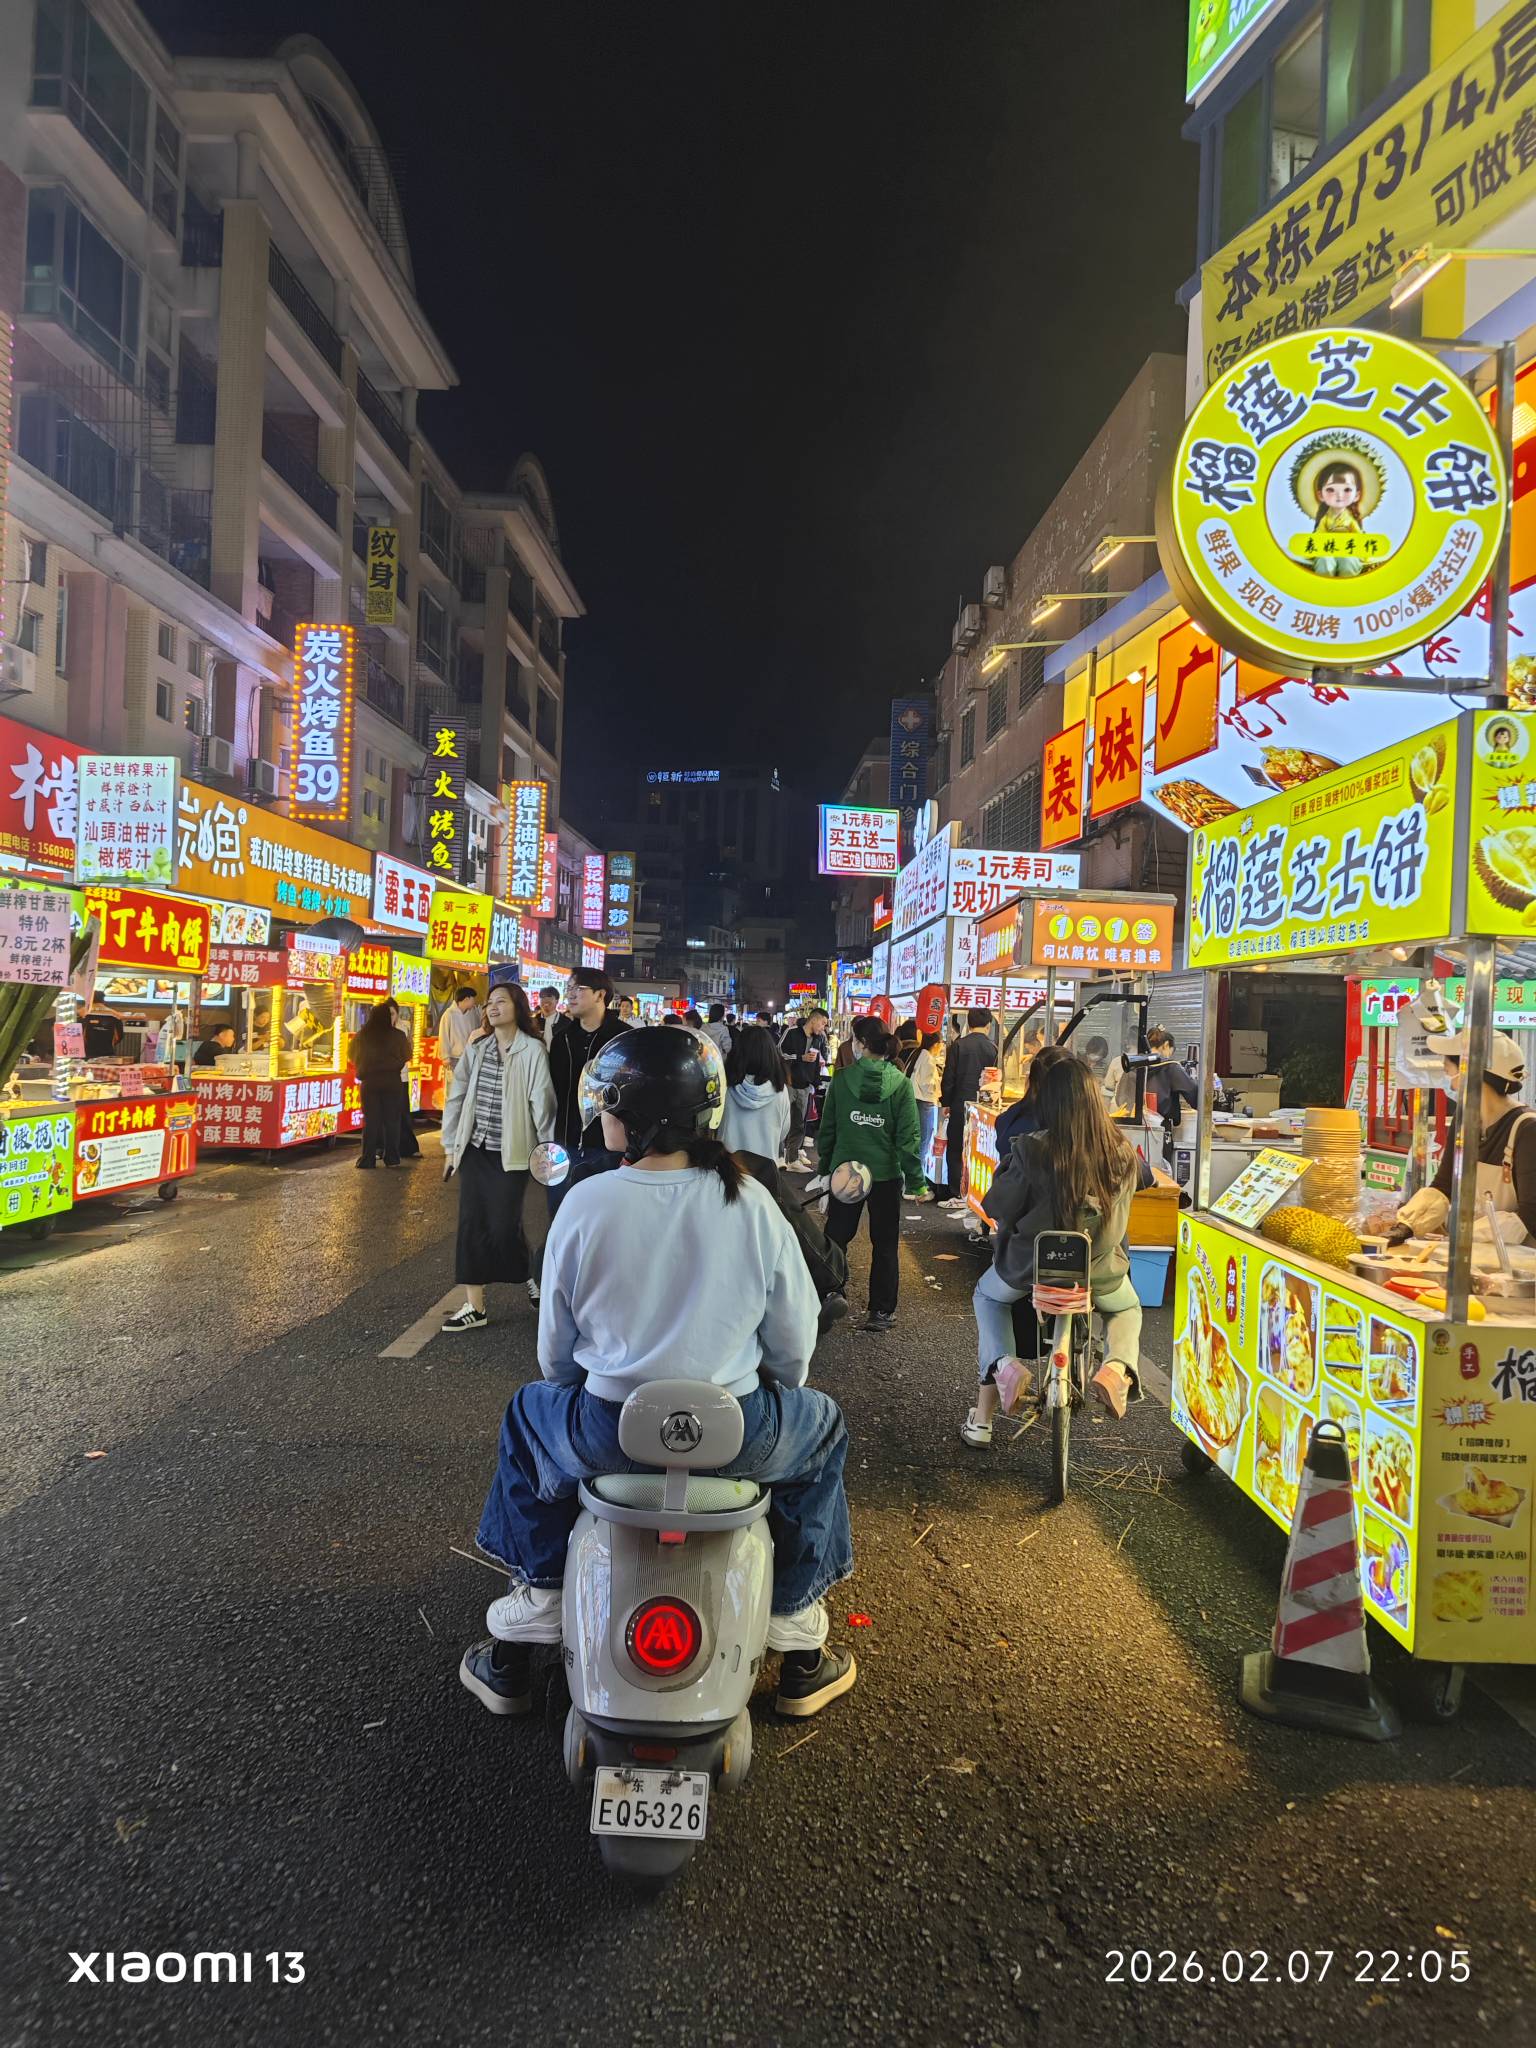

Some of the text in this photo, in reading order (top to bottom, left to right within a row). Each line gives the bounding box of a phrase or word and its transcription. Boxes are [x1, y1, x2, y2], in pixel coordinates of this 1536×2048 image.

[1186, 339, 1497, 512] 榴莲芝士饼
[369, 530, 396, 591] 纹身
[1204, 528, 1242, 579] 鲜果
[1237, 577, 1283, 622] 现包
[1291, 609, 1341, 639] 现烤
[300, 631, 343, 761] 炭火烤鱼
[86, 762, 168, 778] 吴记鲜榨果汁
[1045, 755, 1078, 824] 表
[1095, 706, 1138, 789] 妹
[295, 763, 340, 803] 39
[427, 728, 460, 869] 炭火烤鱼
[84, 822, 167, 844] 汕頭油柑汁
[842, 813, 883, 829] 1元寿司
[511, 786, 541, 898] 潜江油焖大虾
[830, 828, 896, 849] 买五送一
[99, 847, 151, 869] 橄榄汁
[250, 837, 372, 899] 我们始终坚持活鱼与木炭现烤
[977, 856, 1053, 882] 1元寿司
[1200, 810, 1423, 937] 榴莲芝士饼
[385, 869, 431, 925] 霸王面
[443, 900, 479, 915] 第一家
[19, 915, 49, 933] 特价
[84, 899, 204, 960] 门丁牛肉饼
[42, 938, 66, 953] 2杯
[432, 920, 486, 955] 锅包肉
[233, 951, 279, 963] 香而不腻
[1042, 943, 1099, 962] 何以解忧
[191, 1083, 274, 1103] 州烤小肠
[92, 1104, 157, 1134] 门丁牛肉饼
[850, 1110, 885, 1128] Carlsberg
[196, 1126, 262, 1145] 酥里嫩
[1463, 1346, 1475, 1373] 手工
[631, 1778, 673, 1796] 东莞
